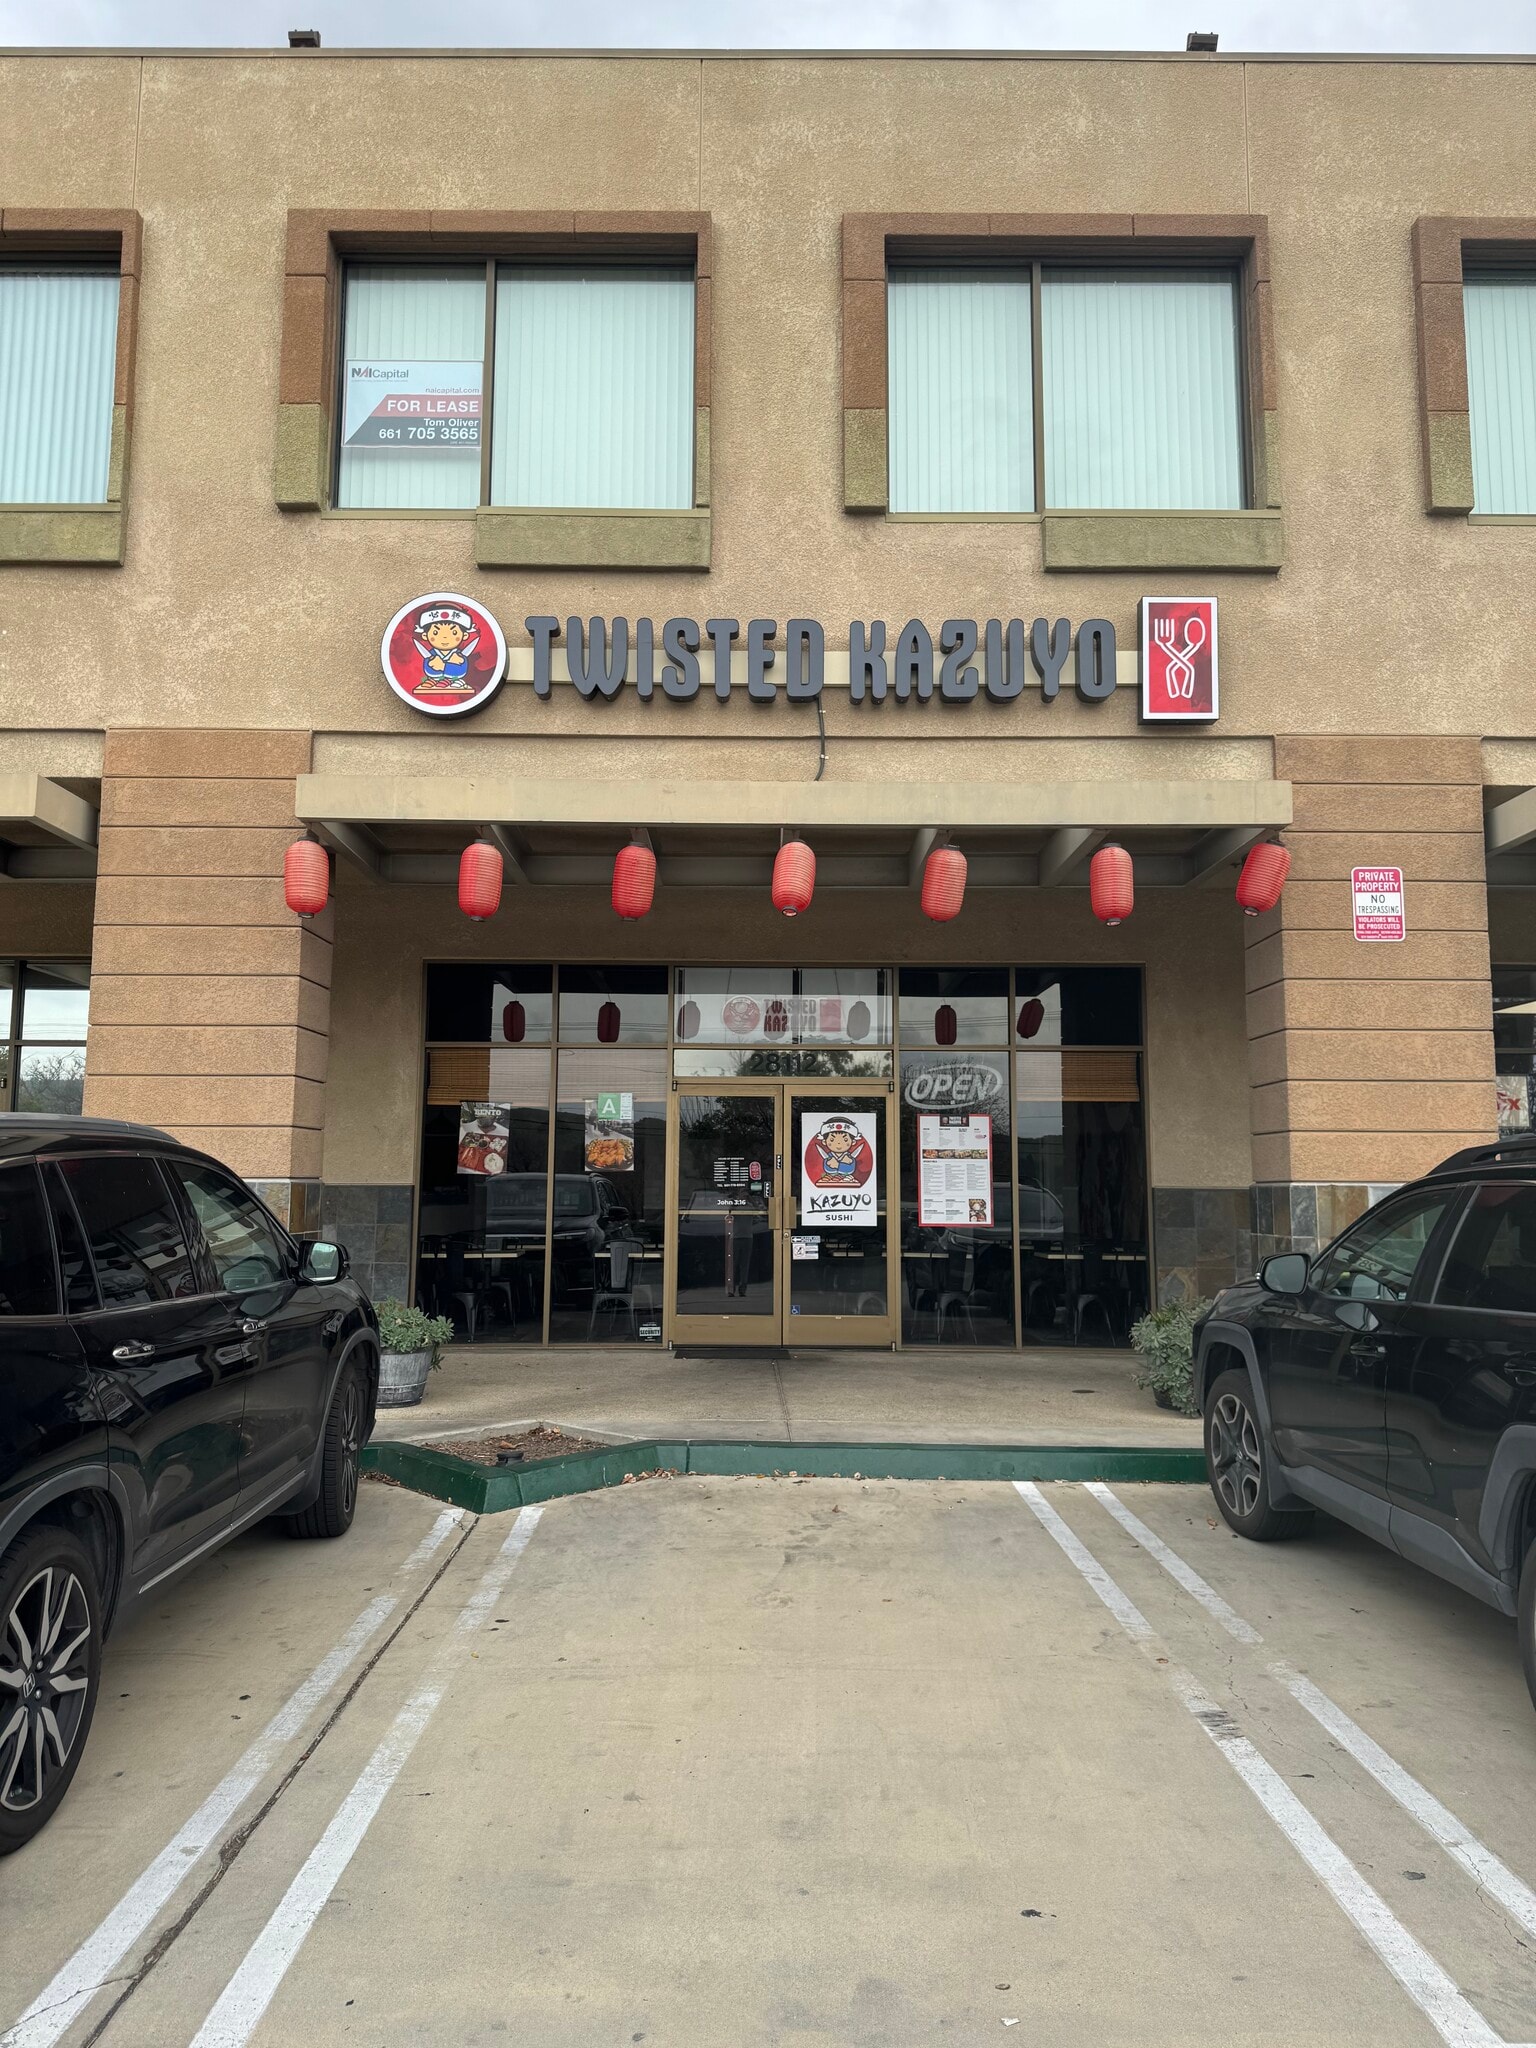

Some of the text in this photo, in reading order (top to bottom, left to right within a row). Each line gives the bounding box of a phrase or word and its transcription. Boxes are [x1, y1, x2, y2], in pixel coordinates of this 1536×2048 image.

[387, 400, 479, 413] FOR LEASE
[424, 418, 479, 427] Tom Oliver
[378, 427, 479, 440] 661 705 3565
[525, 615, 1117, 704] TWISTED KAZUYO
[1358, 871, 1395, 881] PRIVATE
[1355, 882, 1399, 891] PROPERTY
[1370, 894, 1386, 904] NO
[1358, 905, 1400, 914] TRESPASSING
[751, 1053, 817, 1073] 28112
[911, 1074, 992, 1101] OPEN
[601, 1098, 616, 1114] A
[810, 1193, 872, 1211] KAZUYO
